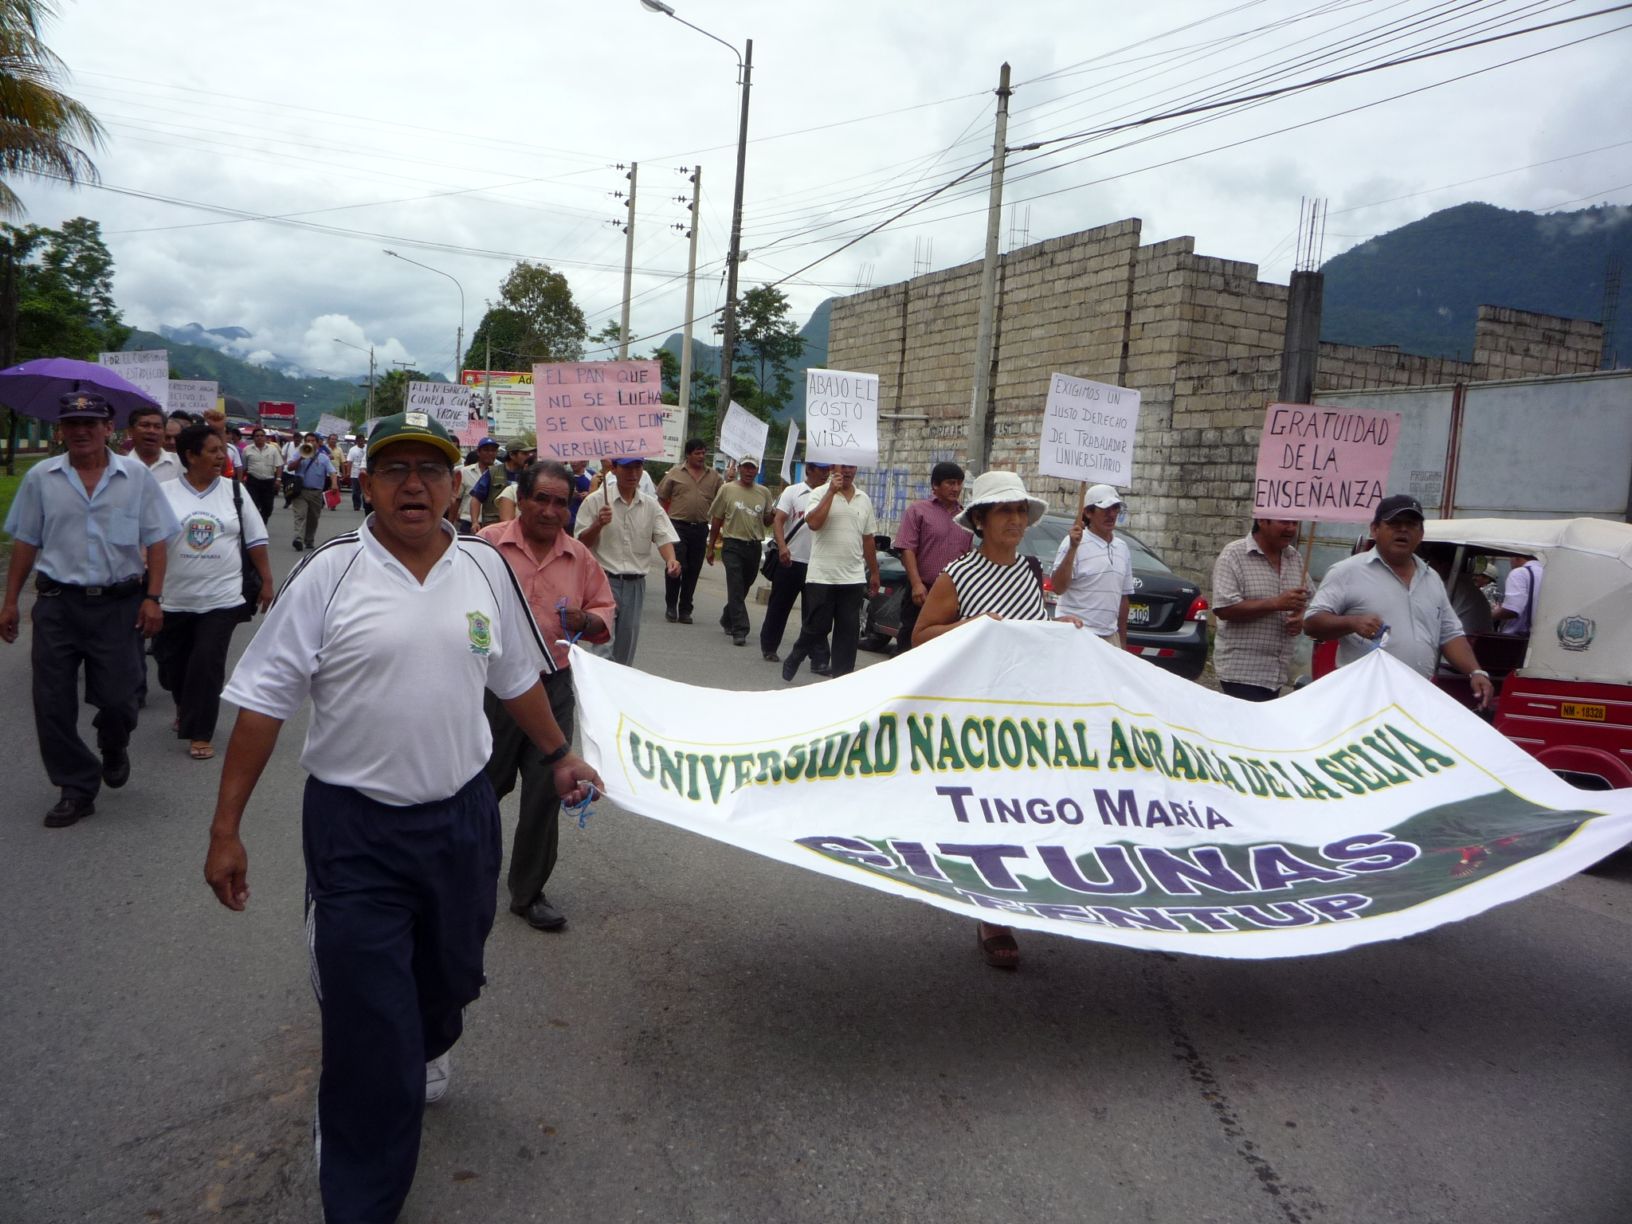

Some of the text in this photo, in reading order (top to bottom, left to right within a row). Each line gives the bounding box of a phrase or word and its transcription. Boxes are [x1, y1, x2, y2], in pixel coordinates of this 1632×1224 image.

[518, 375, 534, 385] Ad
[546, 367, 648, 385] EL PAN QUE
[809, 374, 876, 402] ABAJO EL
[410, 394, 469, 407] CUMPLA CON
[549, 394, 571, 409] NO
[583, 391, 605, 406] SE
[618, 389, 662, 406] LUCHA
[1055, 379, 1120, 406] EXIGIMOS UN
[808, 399, 863, 419] COSTO
[1050, 405, 1127, 429] JUSTO DERECHO
[546, 416, 568, 432] SE
[581, 415, 621, 432] COME
[638, 413, 663, 429] CON
[829, 418, 848, 432] DE
[1270, 409, 1389, 446] GRATUIDAD
[1048, 427, 1127, 454] DEL TRABAJADOR
[1056, 447, 1120, 473] UNIVERSITARIO
[1278, 443, 1338, 472] DE LA
[1255, 475, 1384, 509] ENSEÑANZA
[1563, 704, 1575, 716] NM
[628, 711, 899, 806] UNIVERSIDAD
[907, 711, 1099, 773] NACIONAL
[1229, 754, 1293, 799] DE
[1269, 760, 1344, 801] LA
[1316, 722, 1457, 796] SELVA
[936, 785, 1234, 830] TINGO MARÍA
[792, 832, 1422, 897] SITUNAS
[954, 885, 1374, 934] FENTUP
